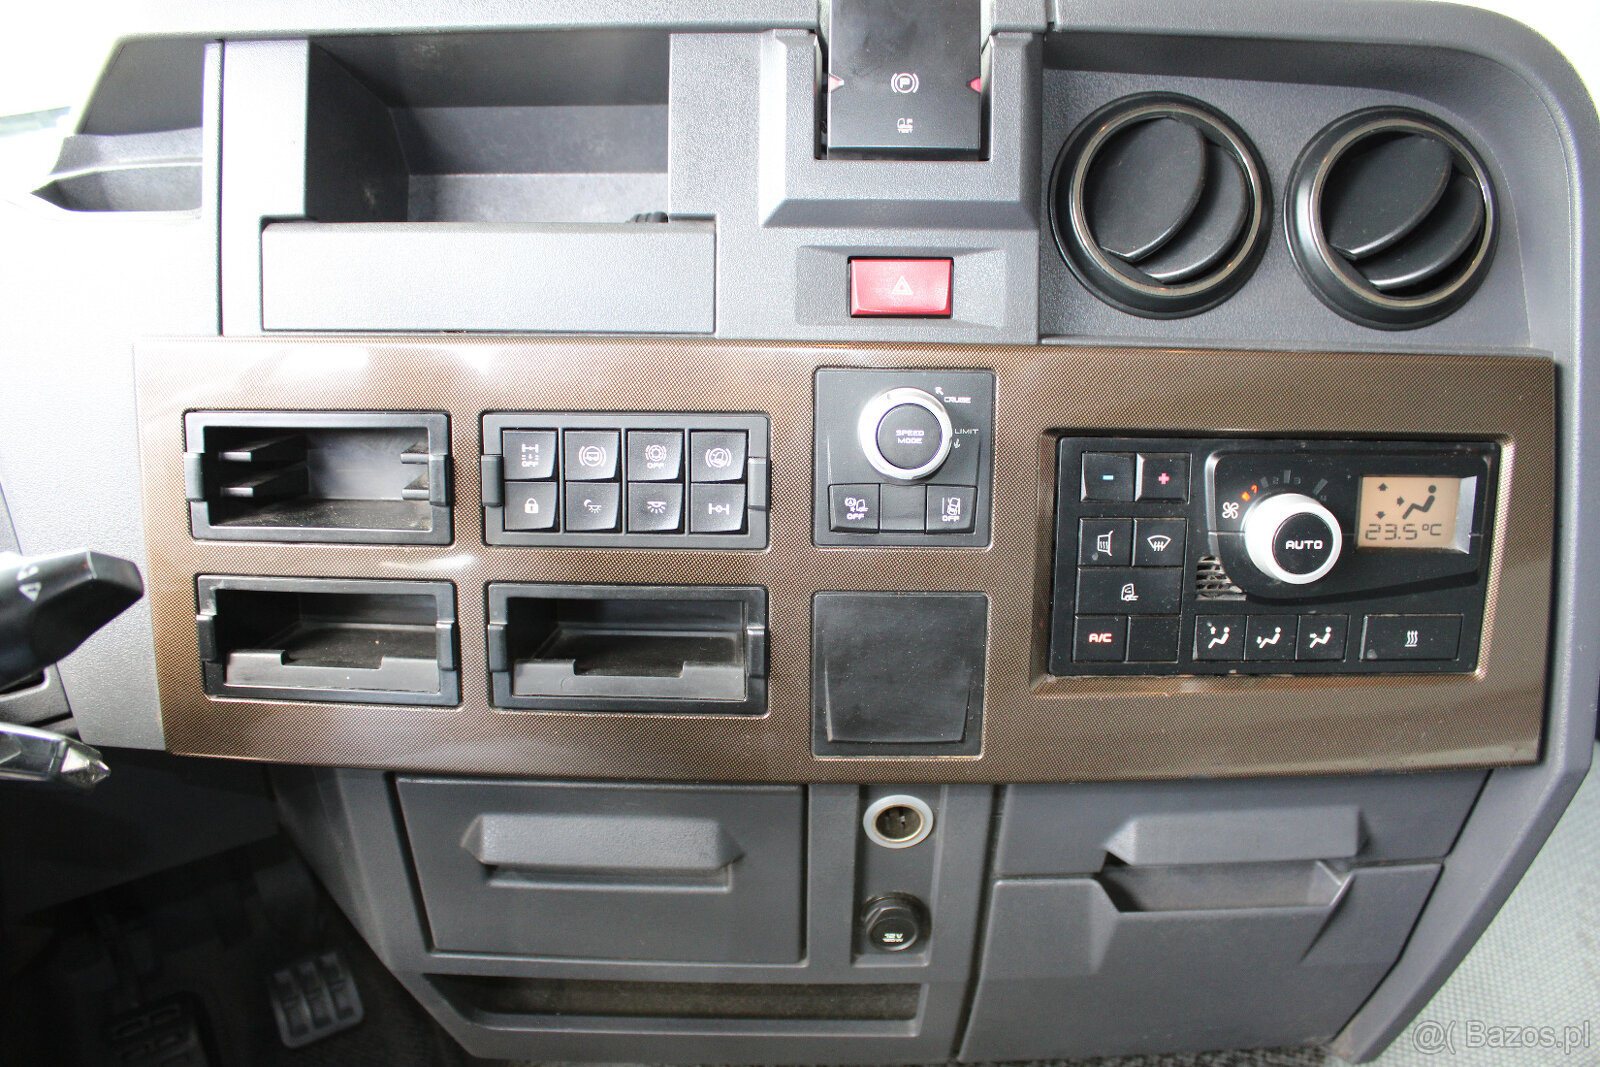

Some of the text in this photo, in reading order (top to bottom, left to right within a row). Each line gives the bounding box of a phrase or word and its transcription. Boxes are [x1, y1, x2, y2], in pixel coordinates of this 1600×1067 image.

[899, 76, 911, 89] P
[895, 429, 925, 437] SPEED
[521, 460, 538, 468] OFF
[646, 461, 665, 469] OFF
[846, 512, 865, 520] OFF
[941, 514, 960, 522] OFF
[1285, 539, 1324, 550] AUTO
[1088, 632, 1113, 643] A/C
